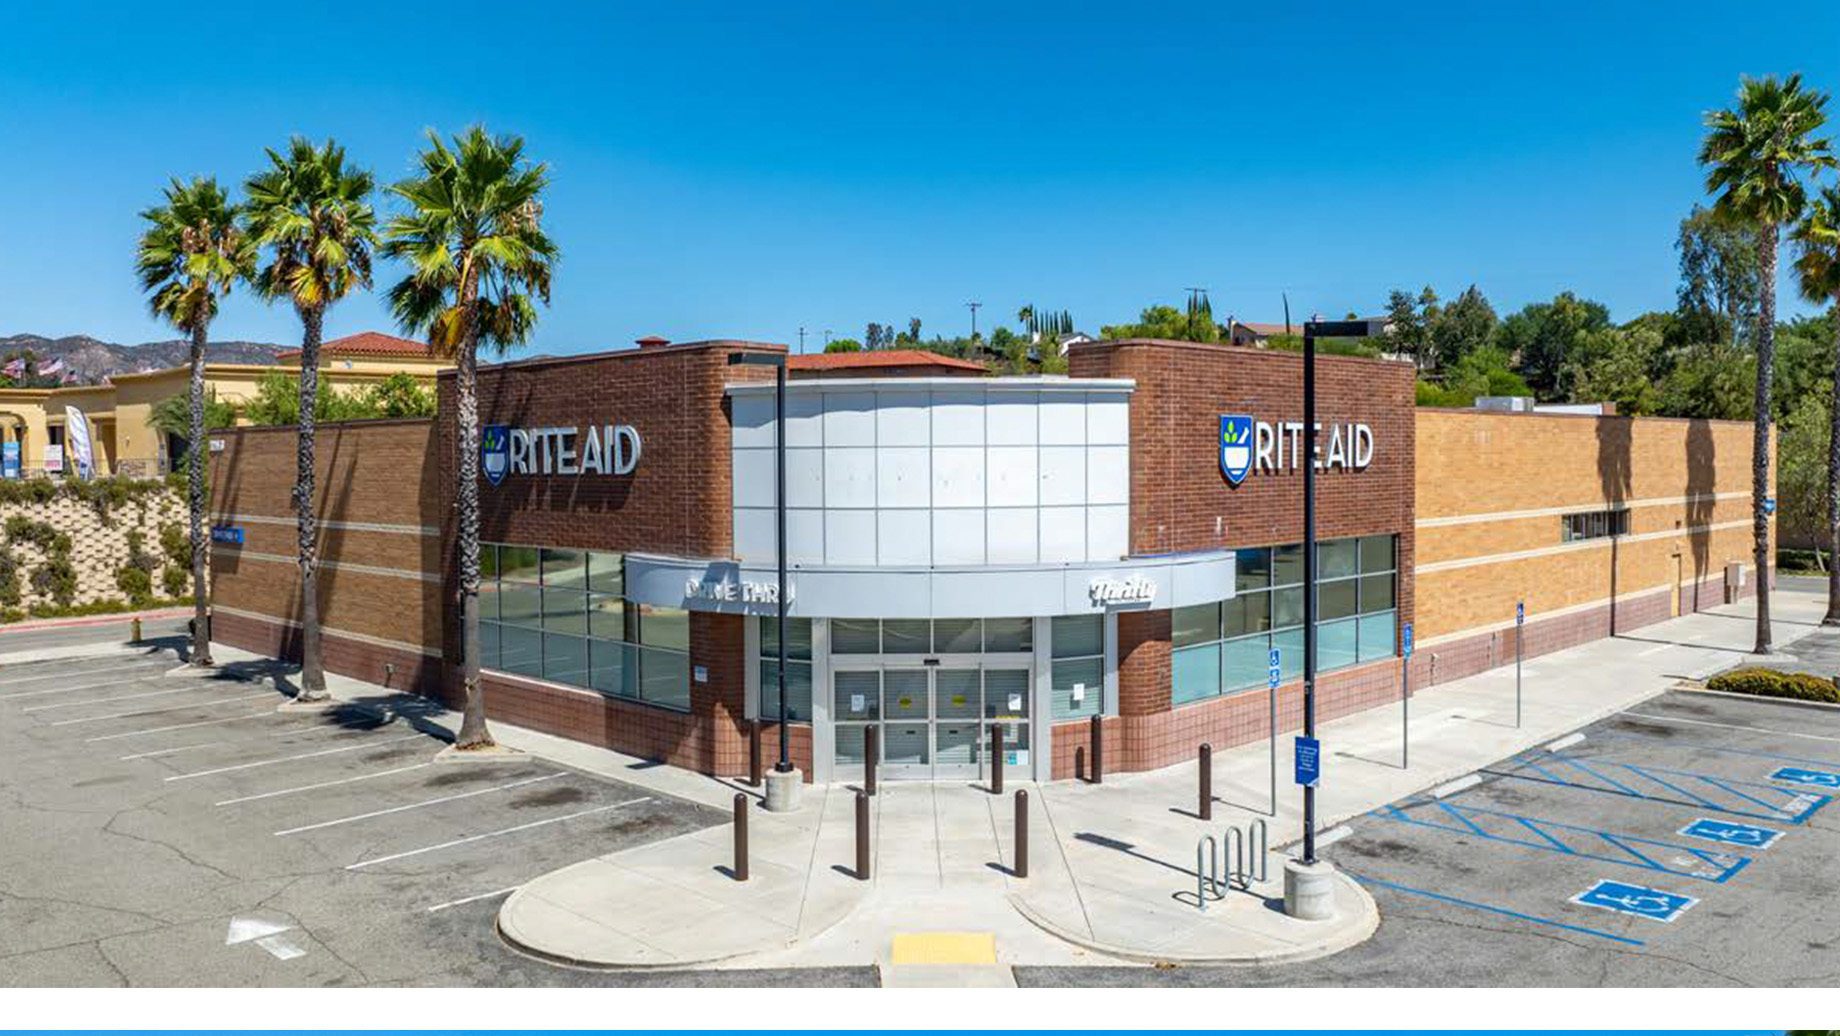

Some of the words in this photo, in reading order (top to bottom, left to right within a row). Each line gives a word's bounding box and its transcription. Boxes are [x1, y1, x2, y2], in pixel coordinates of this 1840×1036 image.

[510, 427, 579, 474] RITE
[581, 425, 641, 474] AID
[1327, 423, 1373, 468] AID
[685, 579, 737, 601] DRIVE
